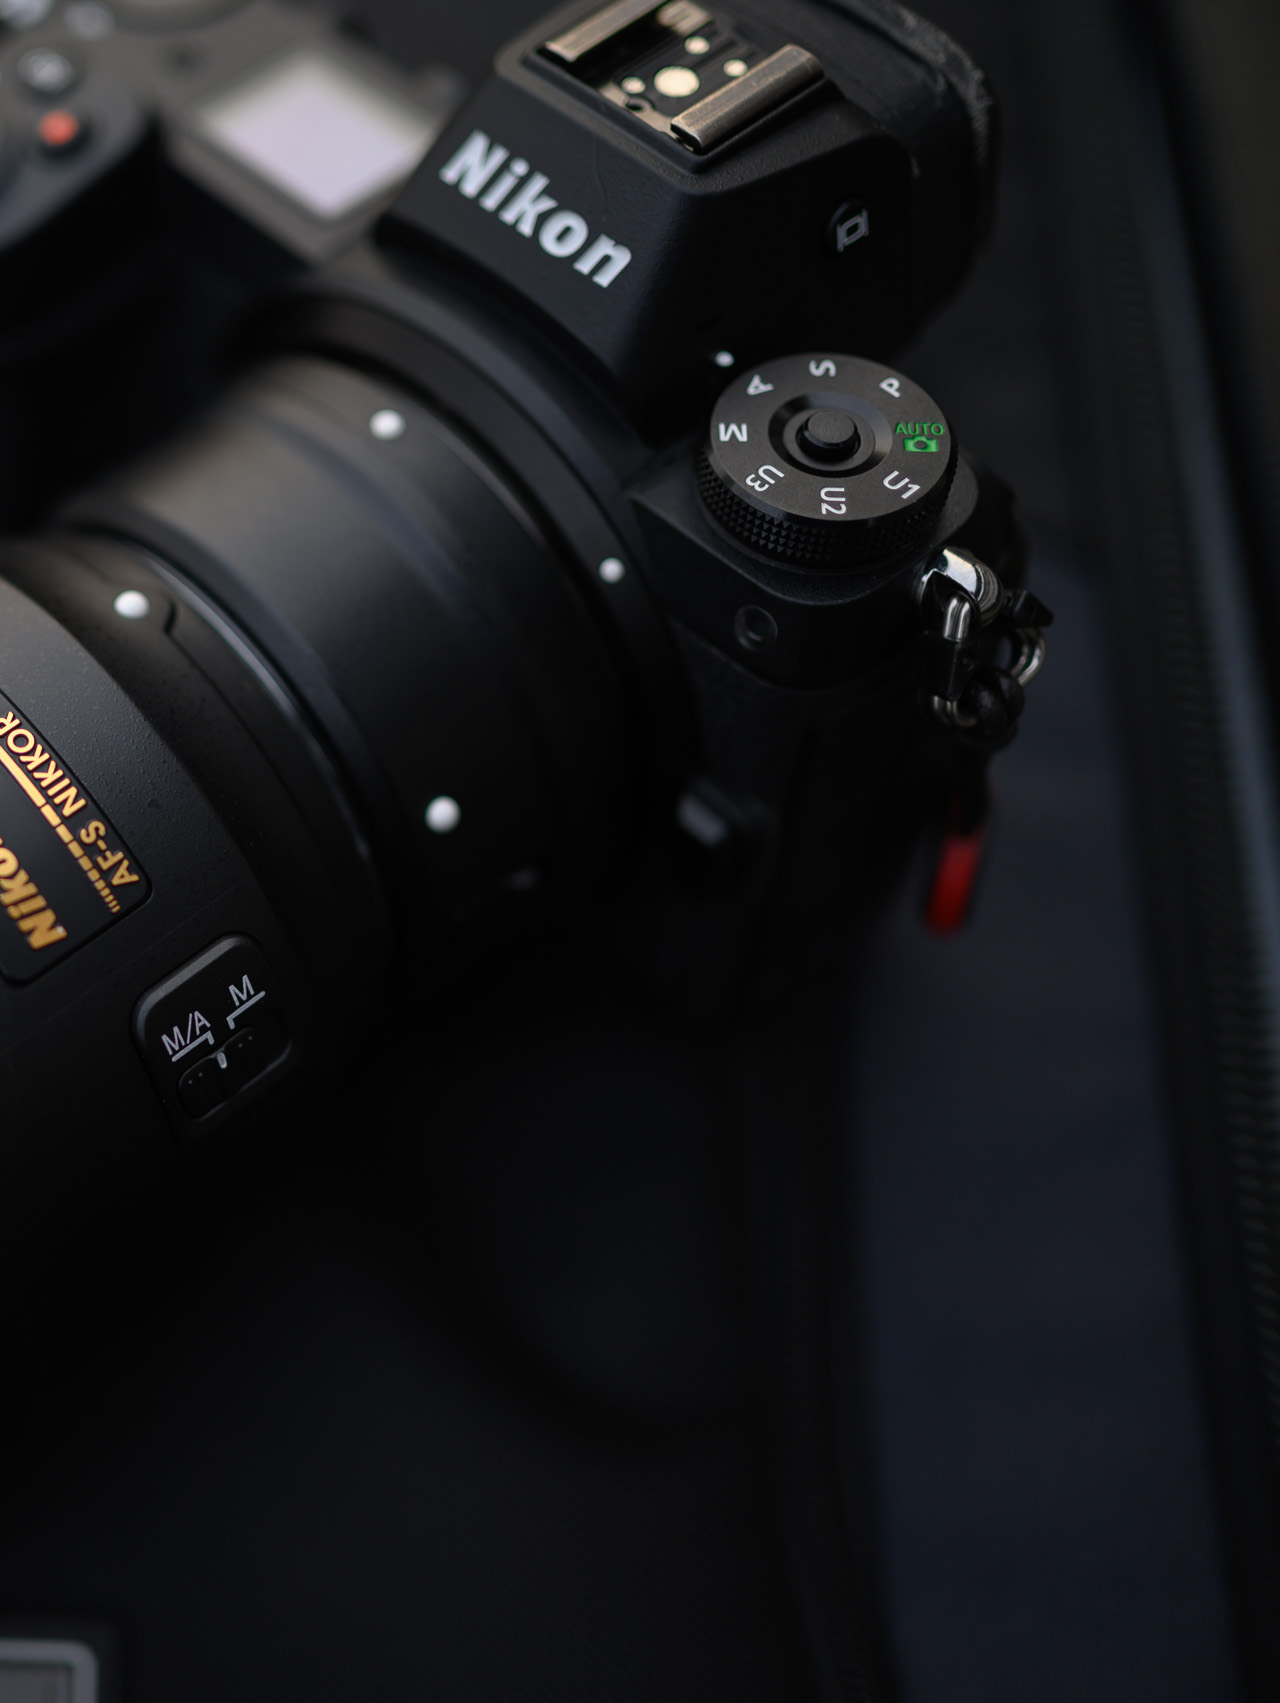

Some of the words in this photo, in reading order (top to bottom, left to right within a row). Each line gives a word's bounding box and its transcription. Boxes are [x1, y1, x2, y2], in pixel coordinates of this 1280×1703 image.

[438, 128, 633, 289] Nikon
[809, 359, 837, 377] S
[746, 374, 775, 396] A
[879, 377, 901, 398] P
[718, 422, 748, 442] M
[895, 422, 944, 436] AUTO
[745, 464, 785, 492] U3
[882, 470, 921, 500] U1
[820, 487, 847, 515] U2
[79, 820, 141, 887] AF-S
[228, 974, 255, 1007] M
[161, 1010, 212, 1055] M/A
